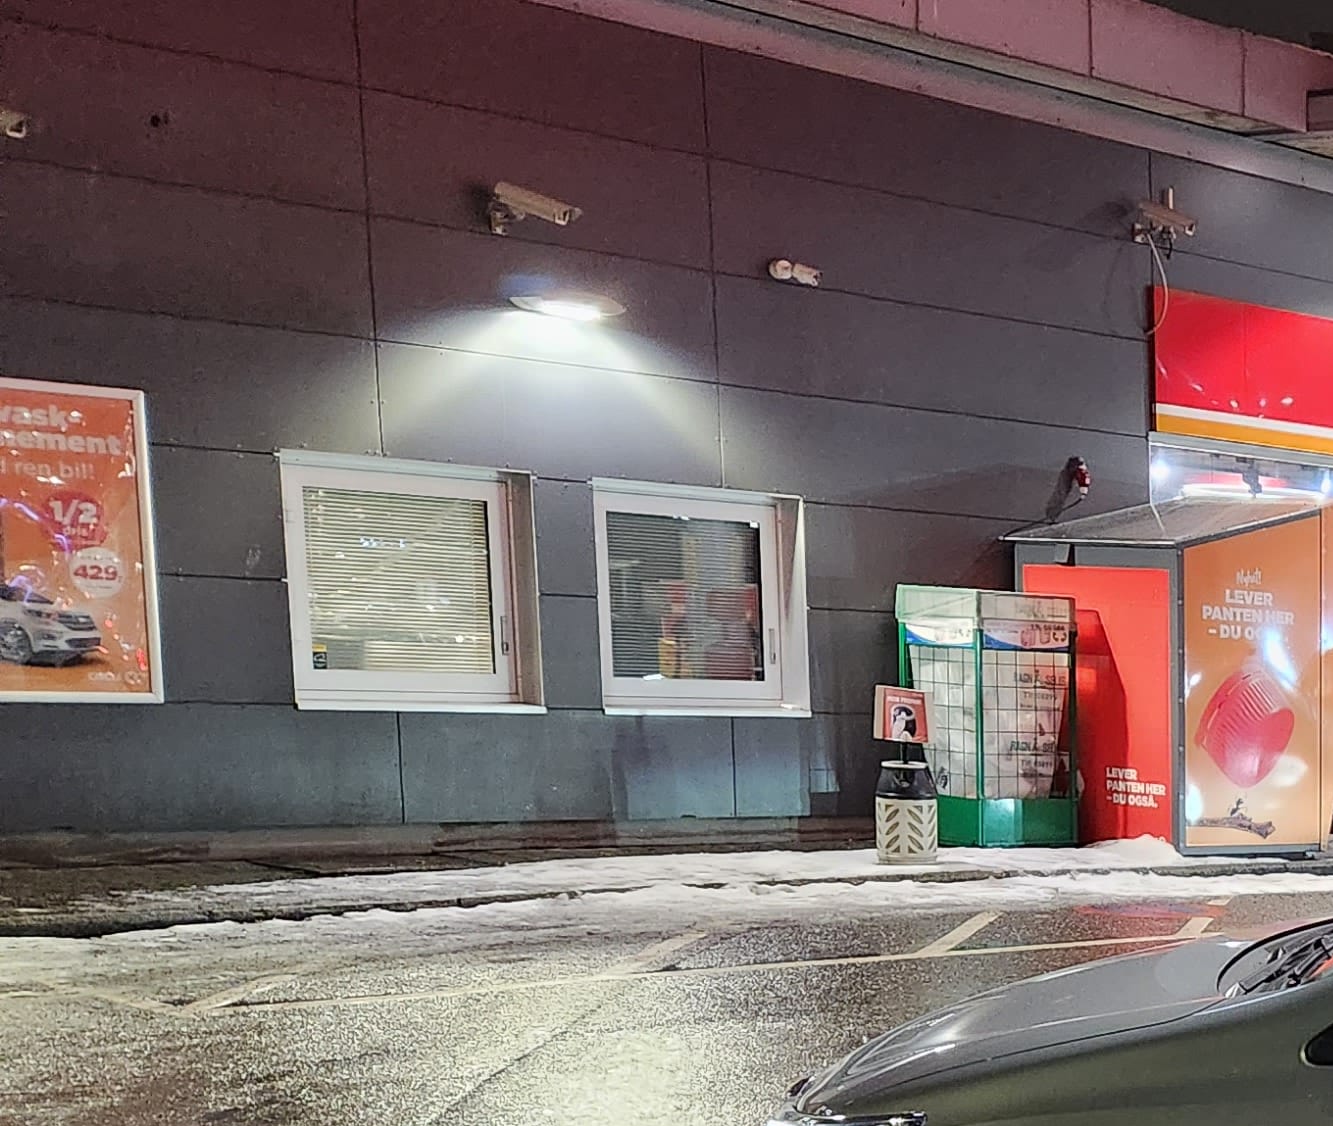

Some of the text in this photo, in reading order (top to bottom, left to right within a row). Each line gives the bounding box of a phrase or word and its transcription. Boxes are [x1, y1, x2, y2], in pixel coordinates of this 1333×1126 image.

[51, 498, 99, 525] 1/2
[1224, 588, 1274, 606] LEVER
[1201, 604, 1295, 625] PANTEN HER
[1219, 624, 1241, 640] DU
[1105, 766, 1138, 781] LEVER
[1105, 779, 1167, 797] PANTEN HER
[1112, 793, 1127, 806] DU
[1127, 794, 1159, 809] OGSÅ.
